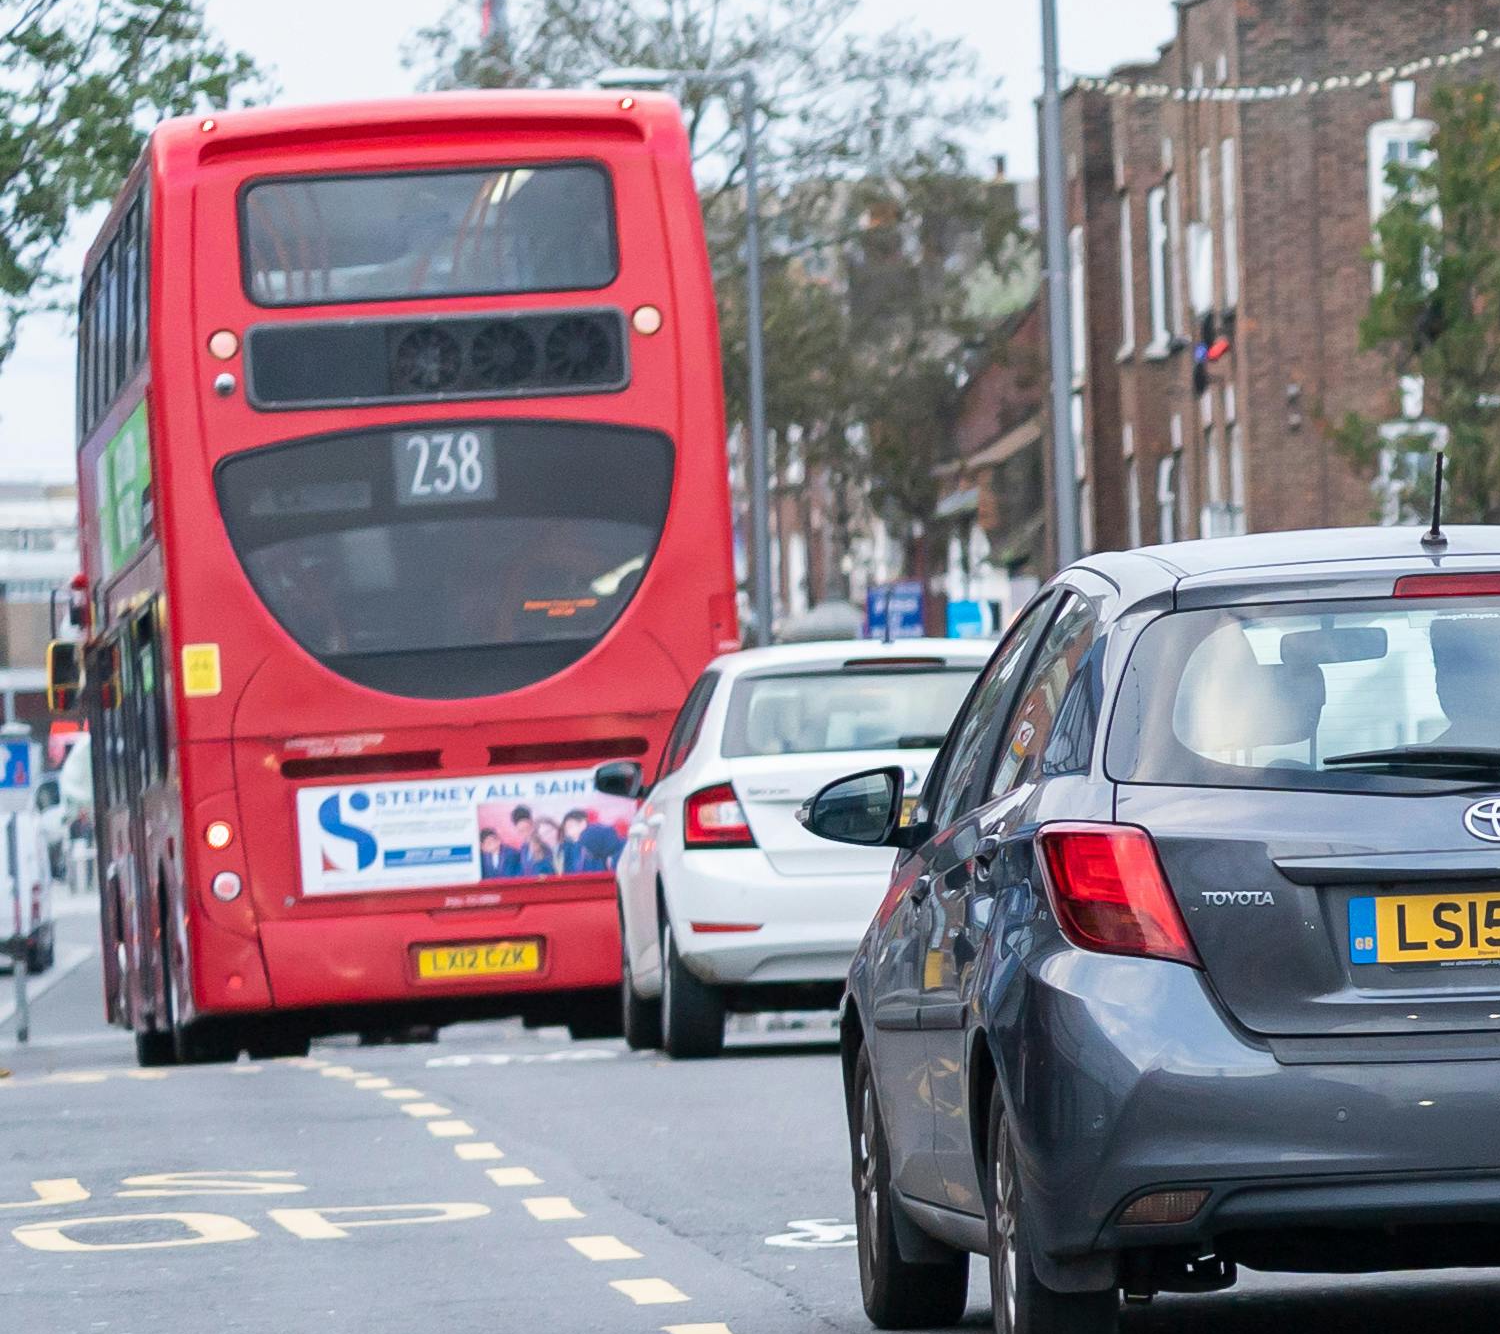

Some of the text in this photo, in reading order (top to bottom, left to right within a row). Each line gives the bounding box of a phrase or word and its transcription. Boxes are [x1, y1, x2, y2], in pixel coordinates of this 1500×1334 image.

[406, 432, 483, 496] 238
[376, 784, 477, 806] STEPNEY
[486, 781, 526, 798] ALL
[1201, 891, 1274, 905] TOYOTA
[1354, 936, 1374, 951] GB
